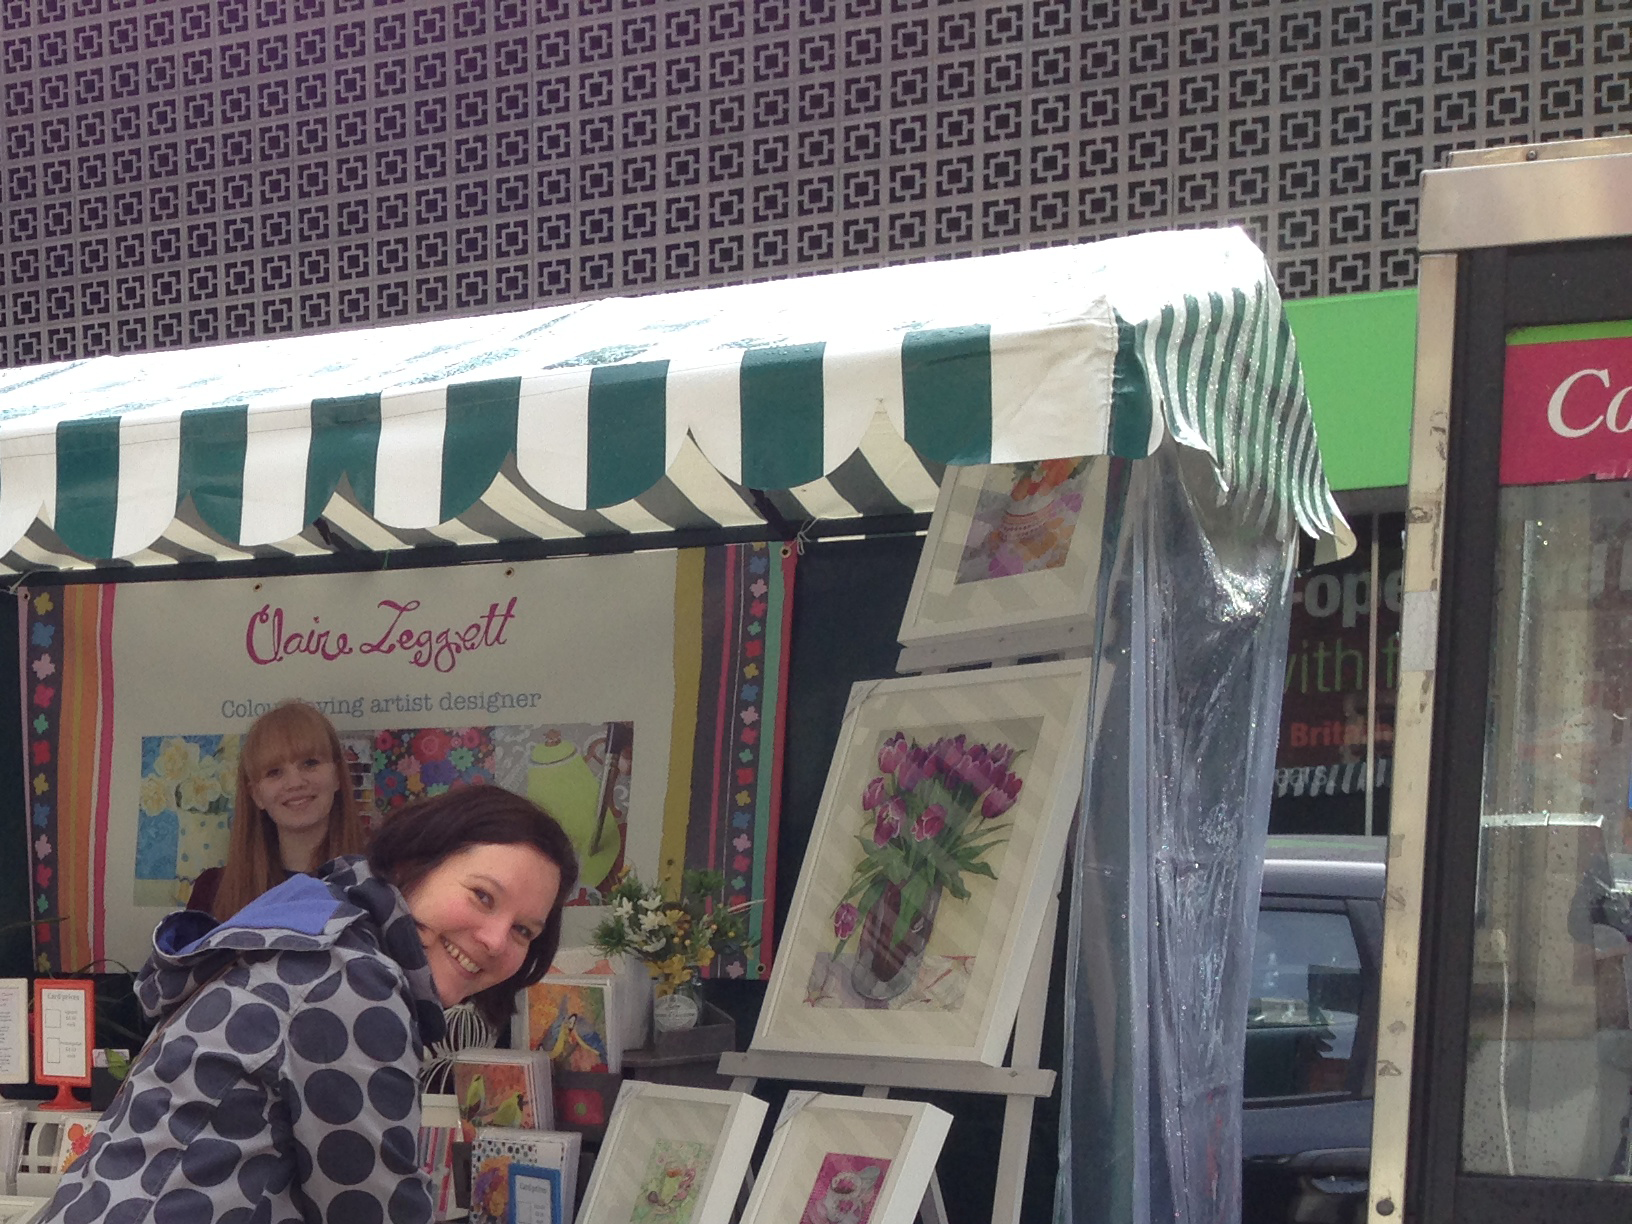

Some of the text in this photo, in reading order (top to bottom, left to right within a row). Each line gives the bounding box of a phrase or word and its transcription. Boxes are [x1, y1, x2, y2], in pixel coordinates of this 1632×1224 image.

[246, 597, 517, 673] Claire Leggett
[221, 691, 542, 718] Colo ving artist designer
